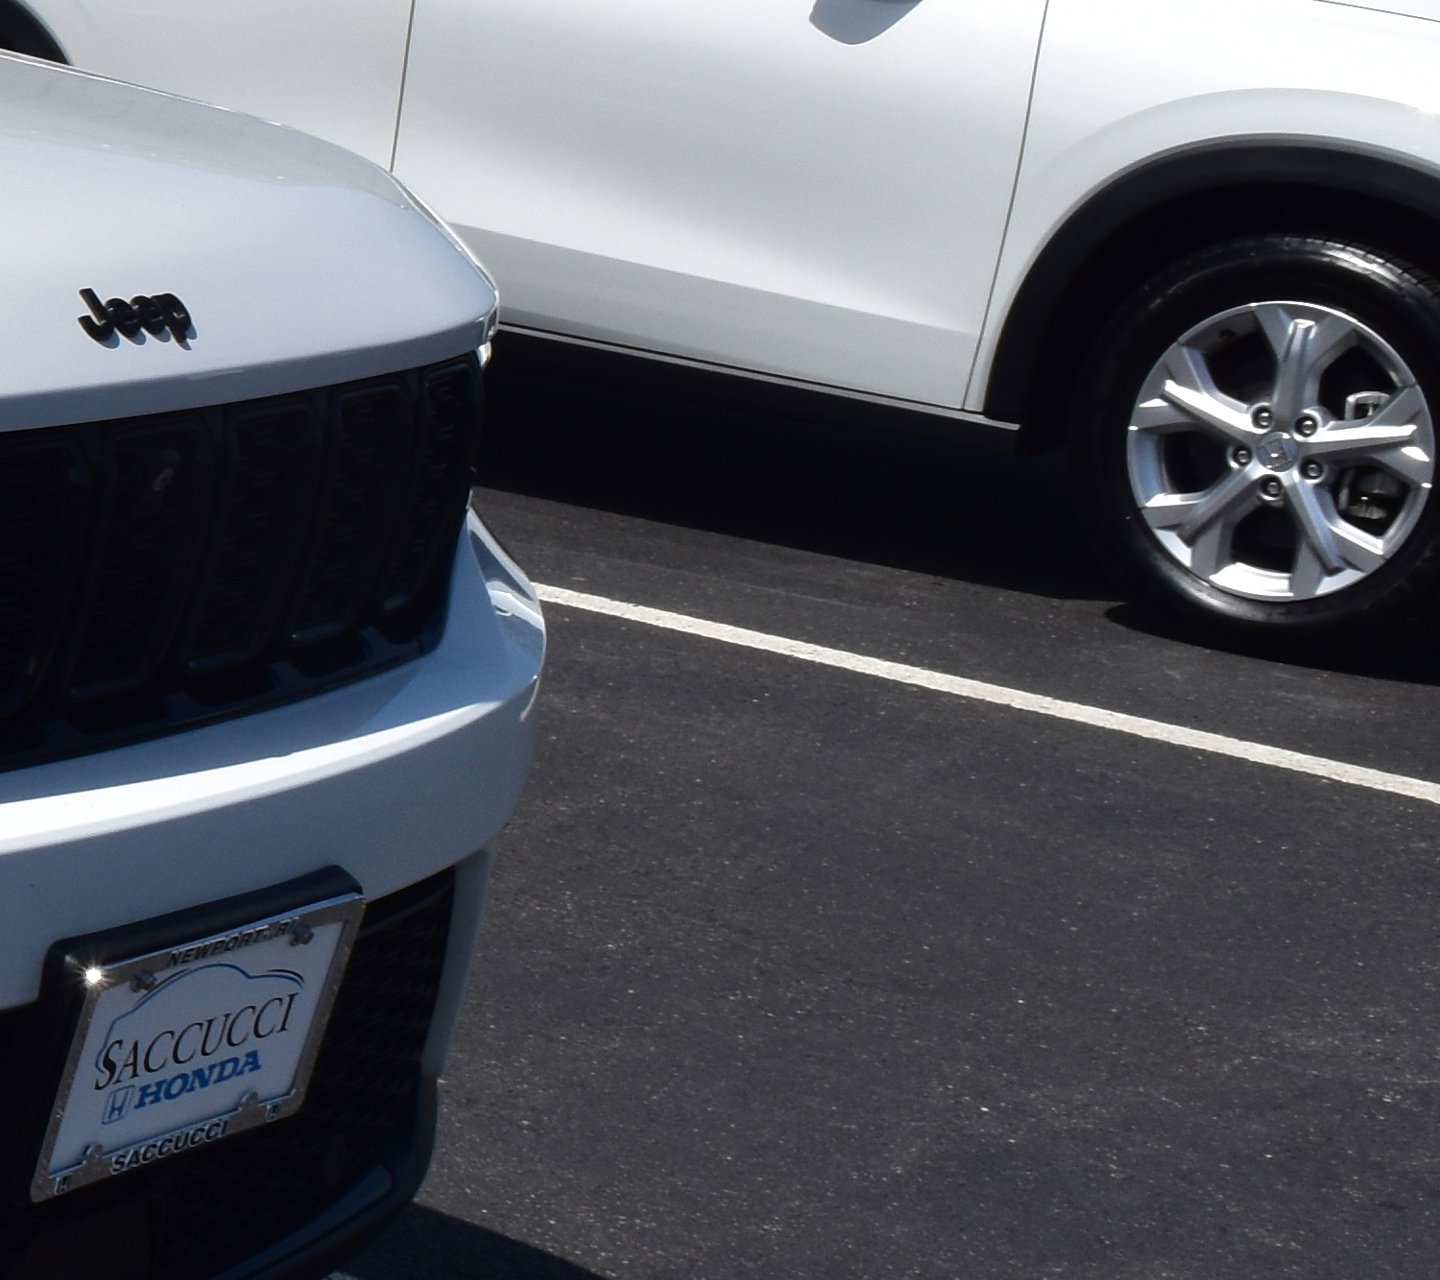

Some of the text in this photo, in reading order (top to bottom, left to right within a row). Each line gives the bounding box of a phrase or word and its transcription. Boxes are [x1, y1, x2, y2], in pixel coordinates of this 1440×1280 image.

[78, 287, 192, 344] Jeep
[94, 992, 299, 1091] SACCUCCI
[134, 1049, 262, 1109] HONDA
[110, 1119, 229, 1175] SACCUCCI
